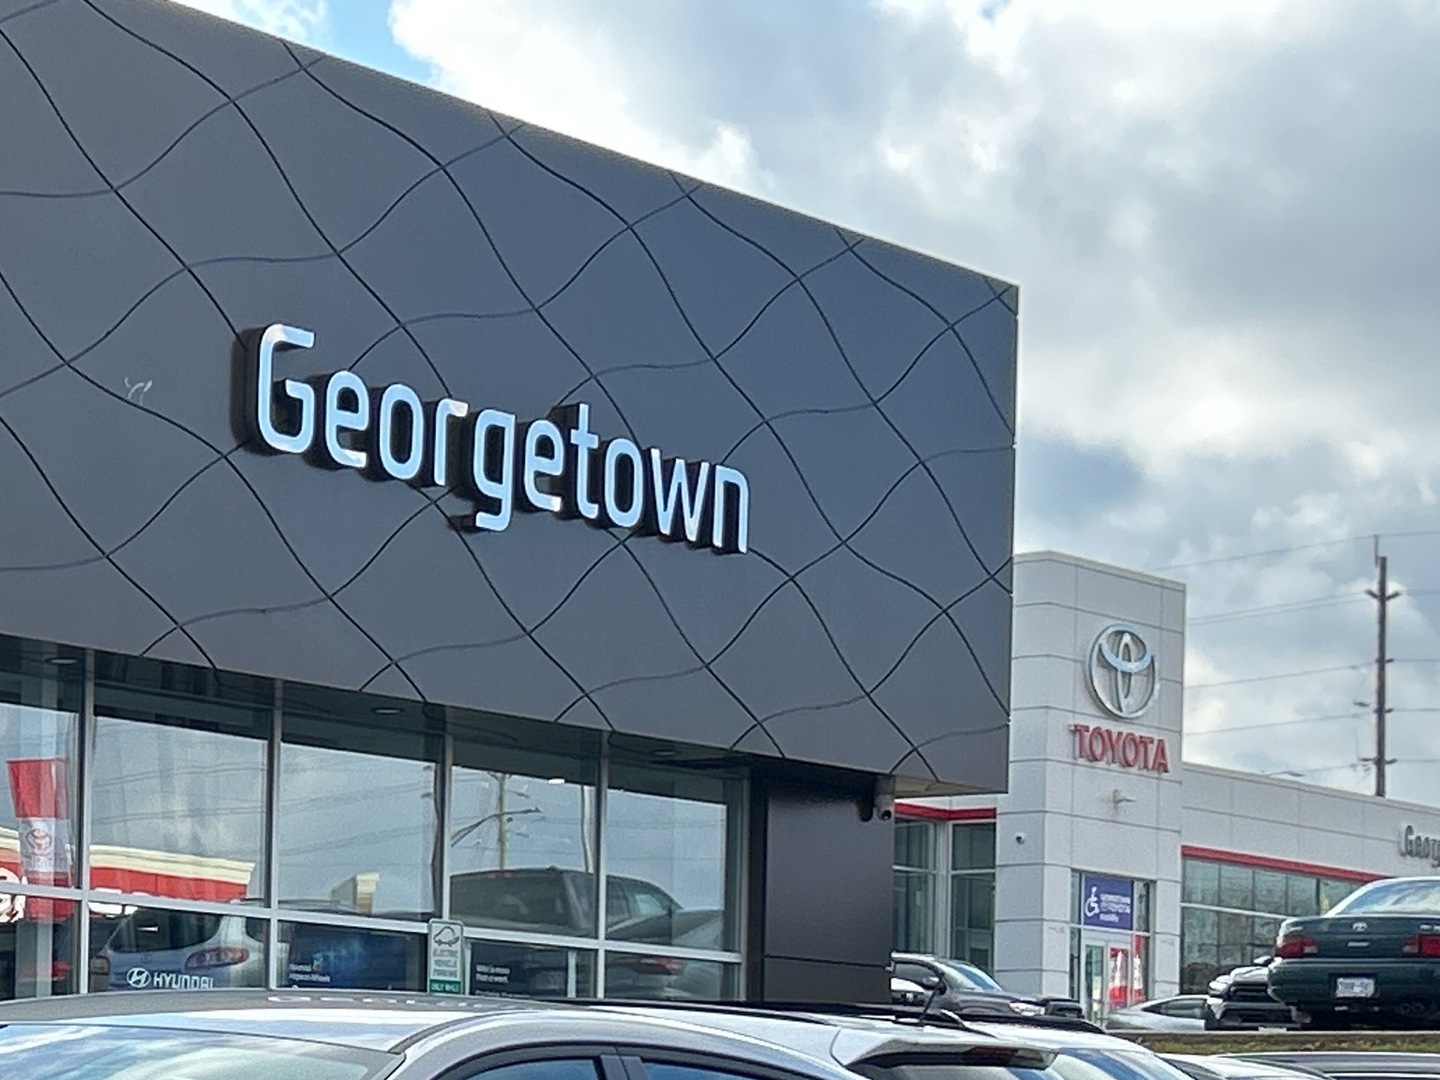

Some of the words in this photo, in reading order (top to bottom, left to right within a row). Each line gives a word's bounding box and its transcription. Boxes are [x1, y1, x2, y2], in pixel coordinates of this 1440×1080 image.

[257, 322, 750, 554] Georgetown
[1073, 724, 1170, 773] TOYOTA
[153, 972, 215, 989] HYUNDAI
